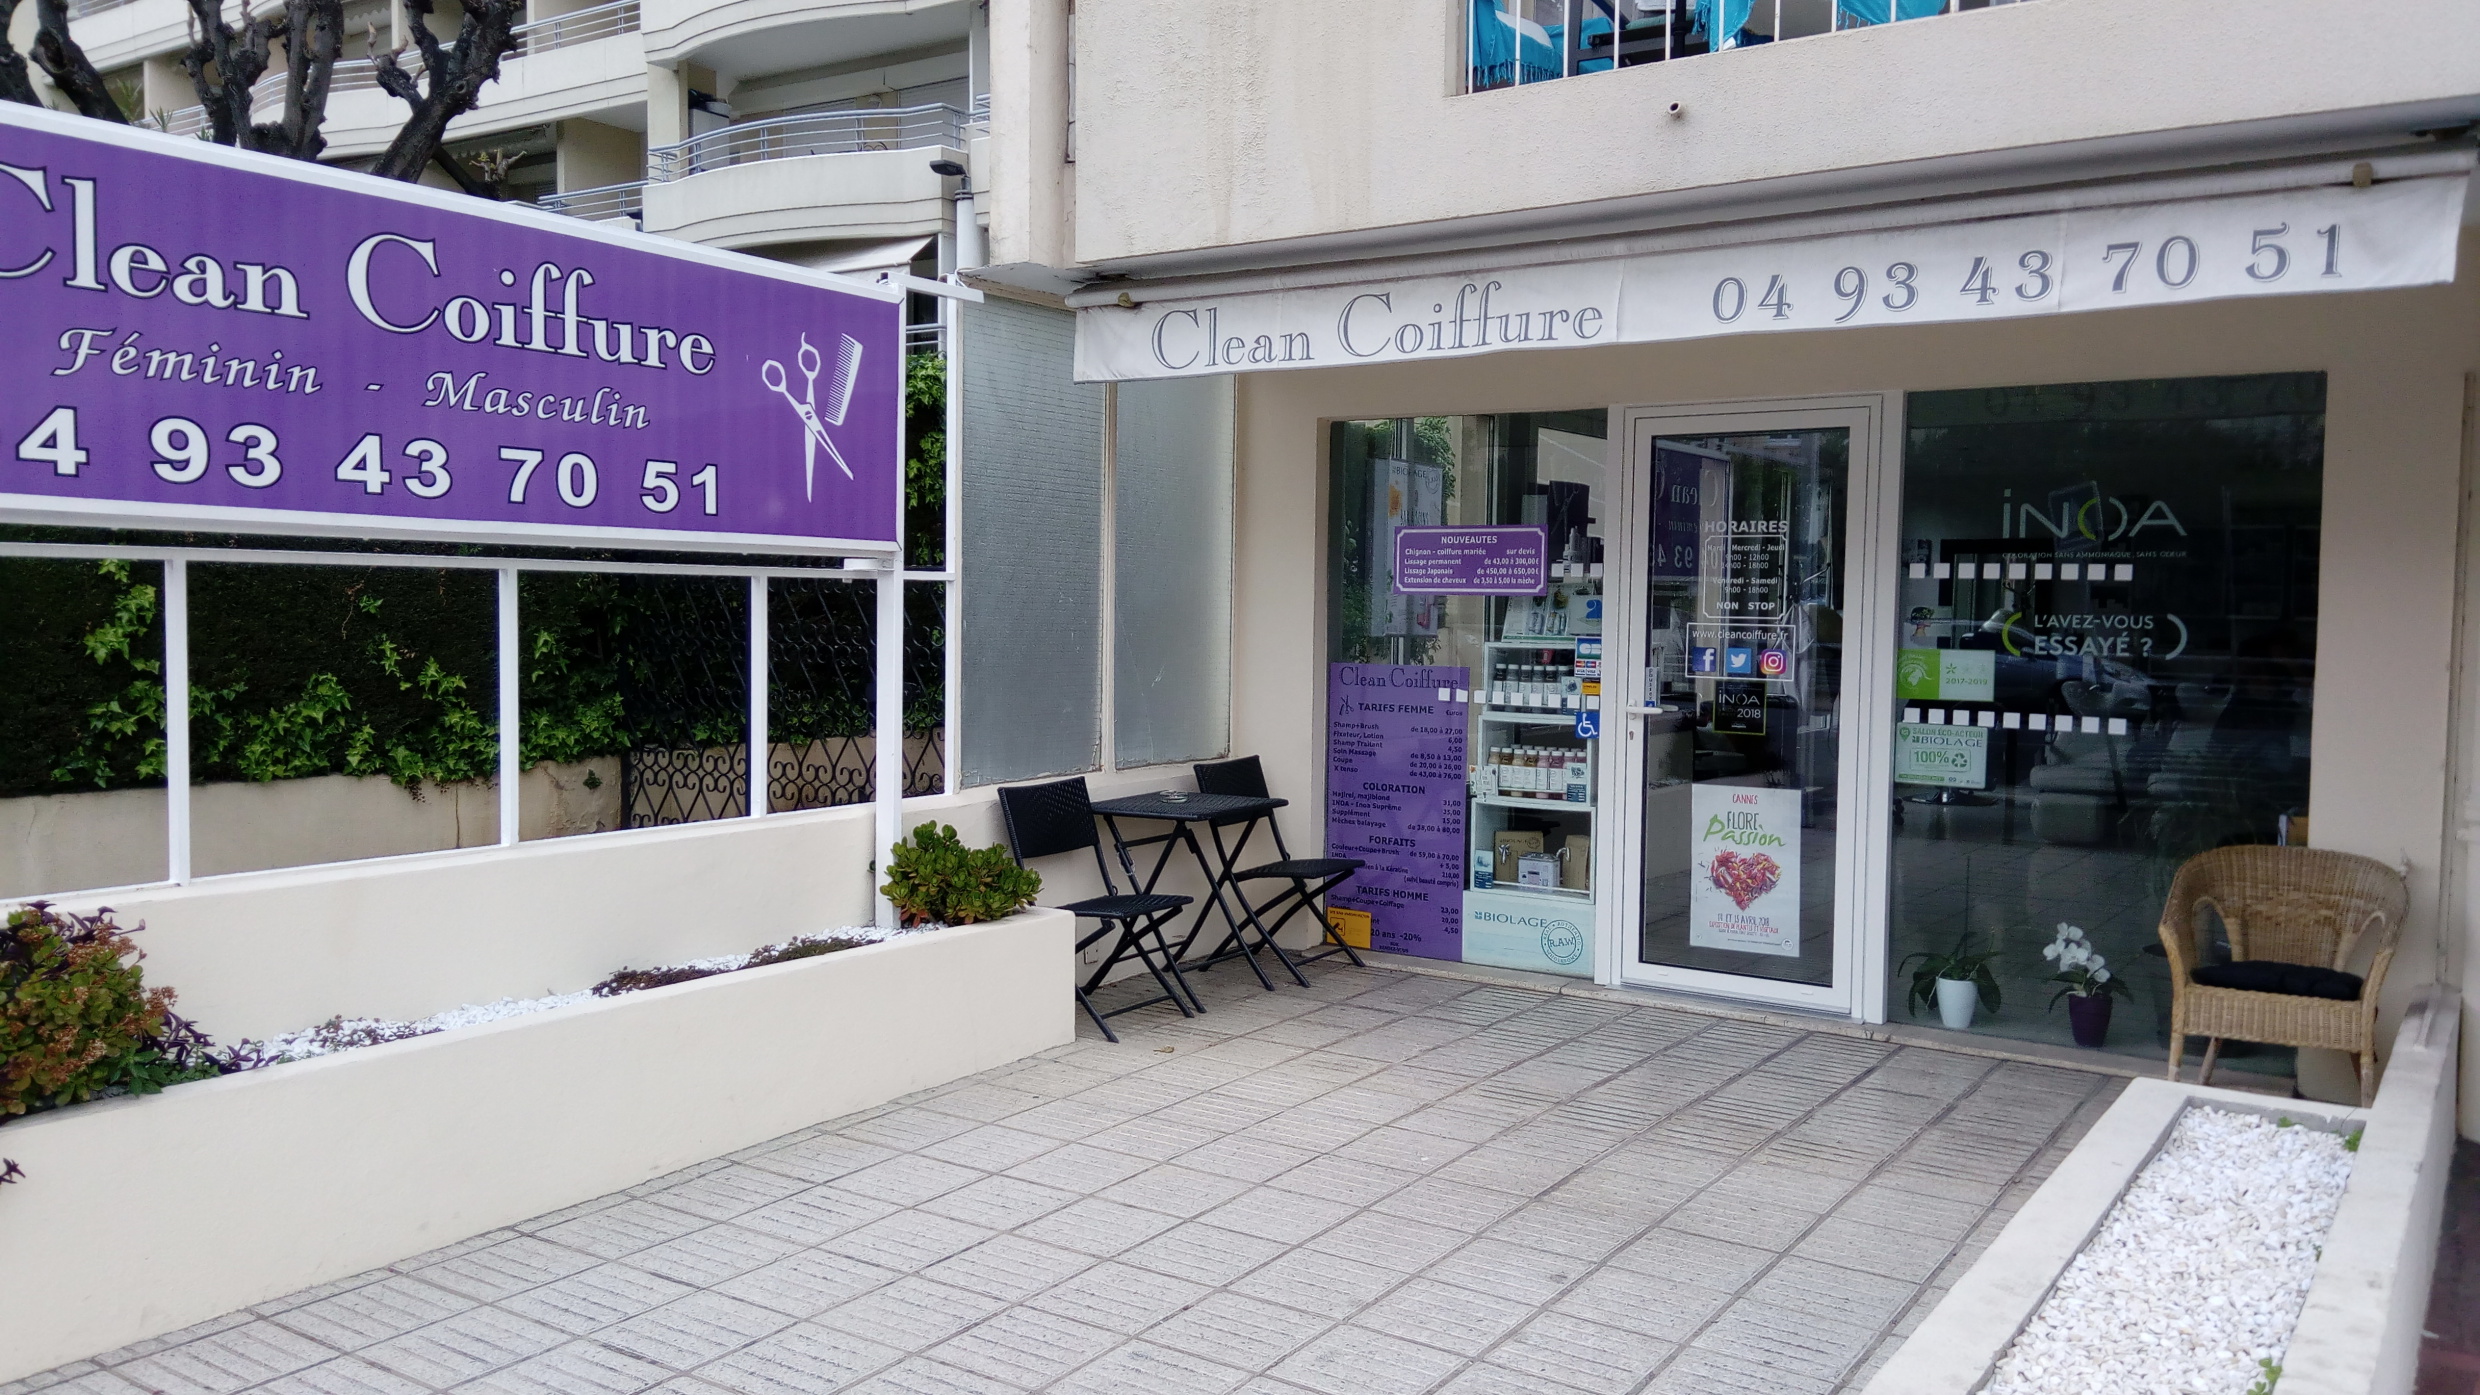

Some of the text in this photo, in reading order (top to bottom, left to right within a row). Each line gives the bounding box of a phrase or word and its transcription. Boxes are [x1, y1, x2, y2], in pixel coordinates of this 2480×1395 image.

[1151, 222, 2343, 369] Clean Coiffure 04 93 43 70 51
[345, 232, 716, 375] Coiffure
[52, 327, 322, 394] Féminin
[423, 371, 650, 429] Masculin
[149, 416, 283, 489] 93
[335, 433, 452, 499] 43
[499, 445, 599, 508] 70
[640, 460, 718, 516] 51
[1705, 521, 1788, 533] HORAIRES
[1441, 536, 1497, 544] NOUVEAUTES
[1464, 547, 1486, 555] mariée
[1405, 558, 1427, 566] Lissage
[1748, 602, 1775, 610] STOP
[2035, 614, 2154, 629] L'AVEZ-VOUS
[1692, 630, 1788, 640] www.cleancoiffure.fr
[2035, 632, 2152, 657] ESSAYÉ ?
[1340, 666, 1458, 689] Clean Coiffure
[1358, 703, 1434, 714] TARIFS FEMME
[1737, 709, 1761, 718] 2018
[1334, 722, 1379, 730] Shamp+Brush
[1921, 737, 1982, 747] BIOLAGE
[1349, 749, 1376, 757] Massage
[1914, 751, 1949, 764] 100%
[1444, 772, 1462, 780] 76,00
[1363, 782, 1425, 794] COLORATION
[1733, 794, 1758, 804] CANNES
[1727, 811, 1759, 830] FLORE
[1703, 814, 1786, 847] Passion
[1369, 835, 1416, 847] FORFAITS
[1356, 886, 1429, 901] TARIFS HOMME
[1484, 912, 1548, 928] BIOLAGE
[1400, 932, 1422, 942] -20%
